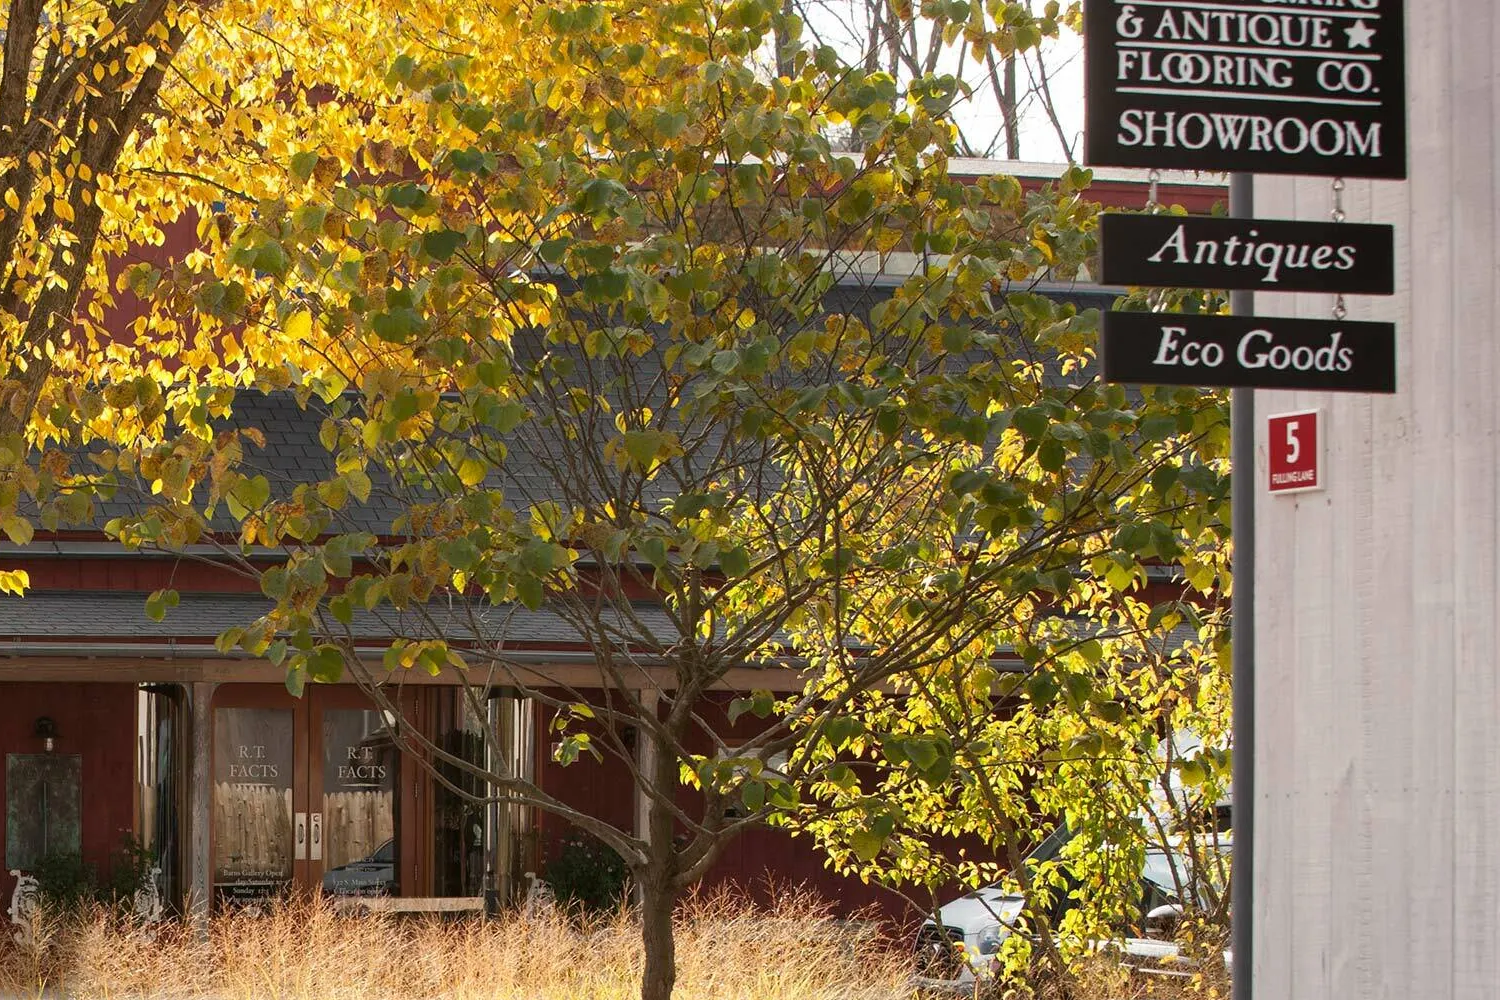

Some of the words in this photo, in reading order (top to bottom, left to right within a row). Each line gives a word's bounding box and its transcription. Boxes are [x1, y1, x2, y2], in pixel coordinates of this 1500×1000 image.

[1116, 5, 1144, 38] &
[1153, 9, 1333, 49] ANTIQUE
[1116, 50, 1294, 88] FLOORING
[1316, 60, 1381, 94] CO.
[1116, 108, 1383, 158] SHOWROOM
[1147, 223, 1357, 283] Antiques
[1152, 325, 1224, 368] Eco
[1236, 329, 1354, 372] Goods
[1286, 421, 1301, 464] 5
[1298, 469, 1314, 481] LANE
[230, 763, 278, 778] FACTS
[238, 744, 266, 759] R.T.
[338, 765, 386, 779] FACTS
[346, 745, 373, 760] R.T.
